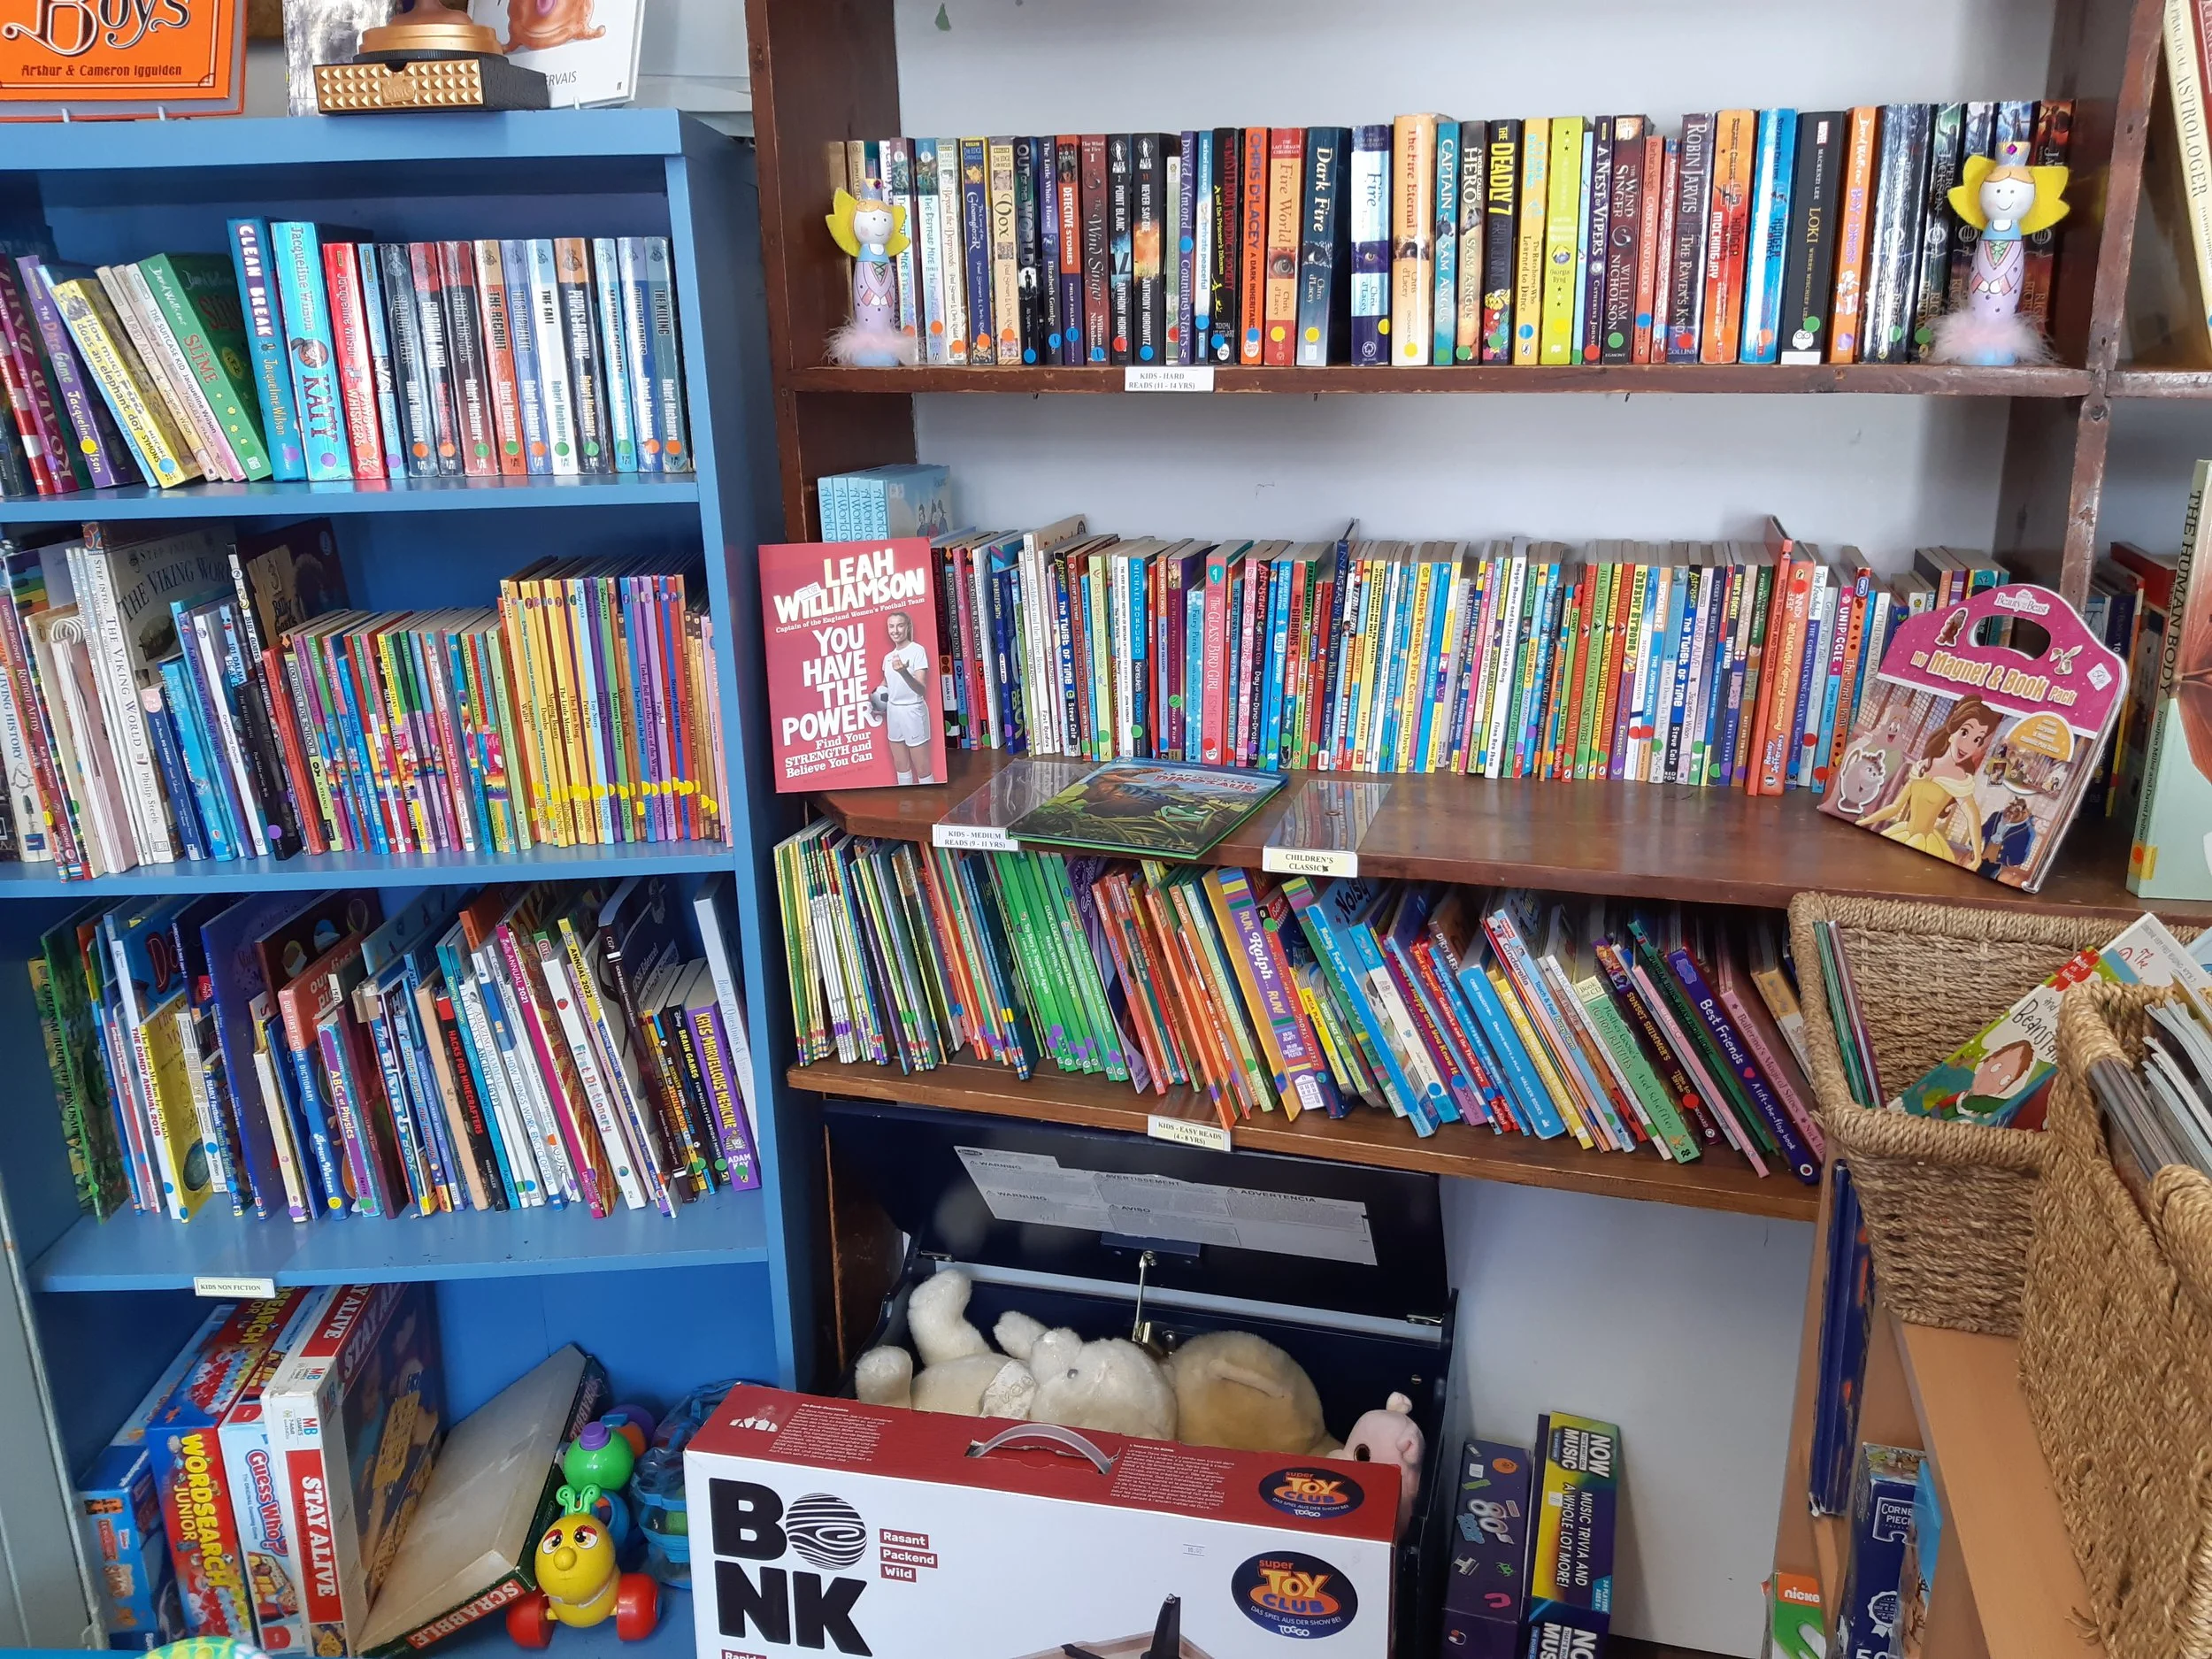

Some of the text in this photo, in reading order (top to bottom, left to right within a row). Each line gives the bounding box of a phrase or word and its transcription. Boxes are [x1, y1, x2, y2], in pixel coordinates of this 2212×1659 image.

[21, 65, 61, 78] Arthur
[66, 65, 74, 76] &
[80, 65, 129, 77] Cameron
[1248, 134, 1262, 173] CHRIS
[1497, 126, 1508, 141] THE
[2176, 74, 2208, 199] ASTROLOGER
[1440, 138, 1455, 210] CAPTAIN
[1463, 147, 1478, 204] HERO
[1488, 142, 1515, 216] DEADLY 7
[1682, 123, 1708, 214] ROBIN JARVIS
[1062, 187, 1072, 228] DETECTIVE
[1313, 147, 1333, 233] Dark Fire
[1805, 207, 1821, 243] LOKI
[236, 225, 274, 337] CLEAN BREAK
[291, 227, 315, 331] Jacqueline Wilson
[488, 292, 507, 350] THE RECRUIT
[1180, 260, 1191, 346] Counting Stars
[302, 373, 338, 442] KATY
[823, 548, 895, 588] LEAH
[773, 568, 926, 624] WILLIAMSON
[776, 624, 801, 634] Captain
[823, 612, 849, 624] England
[851, 607, 879, 618] Women's
[880, 601, 906, 613] Football
[908, 597, 925, 608] Team
[2159, 490, 2201, 700] THE HUMAN BODY
[812, 623, 864, 657] YOU
[105, 615, 142, 747] THE VIKING WORLD
[803, 649, 867, 687] HAVE
[1912, 651, 2078, 705] My Magnet & Book Pack
[817, 675, 869, 709] THE
[782, 701, 884, 746] POWER
[815, 732, 871, 750] Find Your
[785, 741, 872, 768] STRENGTH and
[787, 753, 872, 779] Believe You Can
[1286, 854, 1333, 864] CHILDREN'S
[570, 949, 593, 999] ANNUAL 2022
[1502, 942, 1530, 987] Cinderella
[1267, 990, 1286, 1015] RUN!
[1699, 998, 1744, 1066] Best Friends
[131, 1026, 161, 1136] THE DANDY ANNUAL 2016
[448, 1030, 461, 1062] HACKS
[457, 1072, 484, 1135] MINECRAFTERS
[702, 1033, 730, 1097] MARVELLOUS
[330, 1070, 342, 1095] ABCs
[340, 1107, 355, 1141] Physics
[715, 1091, 739, 1131] MEDICINE
[1158, 1122, 1174, 1131] KIDS
[1199, 1131, 1222, 1140] READS
[1240, 1189, 1316, 1203] ADVERTENCIA
[1562, 1429, 1579, 1470] MUSIC
[1589, 1434, 1610, 1478] NOW
[178, 1483, 196, 1542] JUNIOR
[180, 1434, 231, 1588] WORDSEARCH
[1561, 1494, 1575, 1529] WHOLE
[300, 1476, 337, 1599] STAY ALIVE
[883, 1531, 926, 1546] Rasant
[883, 1549, 934, 1564] Packend
[1560, 1532, 1571, 1551] LOT
[1575, 1492, 1593, 1586] MUSIC TRIVIA AND
[885, 1567, 912, 1578] Wild
[1259, 1559, 1294, 1570] super
[1556, 1552, 1570, 1587] MORE!
[410, 1582, 522, 1648] SCRABBLE
[1250, 1606, 1263, 1616] DAS
[1264, 1611, 1280, 1621] SPIEL
[1263, 1594, 1325, 1614] CLUB
[1278, 1624, 1310, 1636] TOGGO
